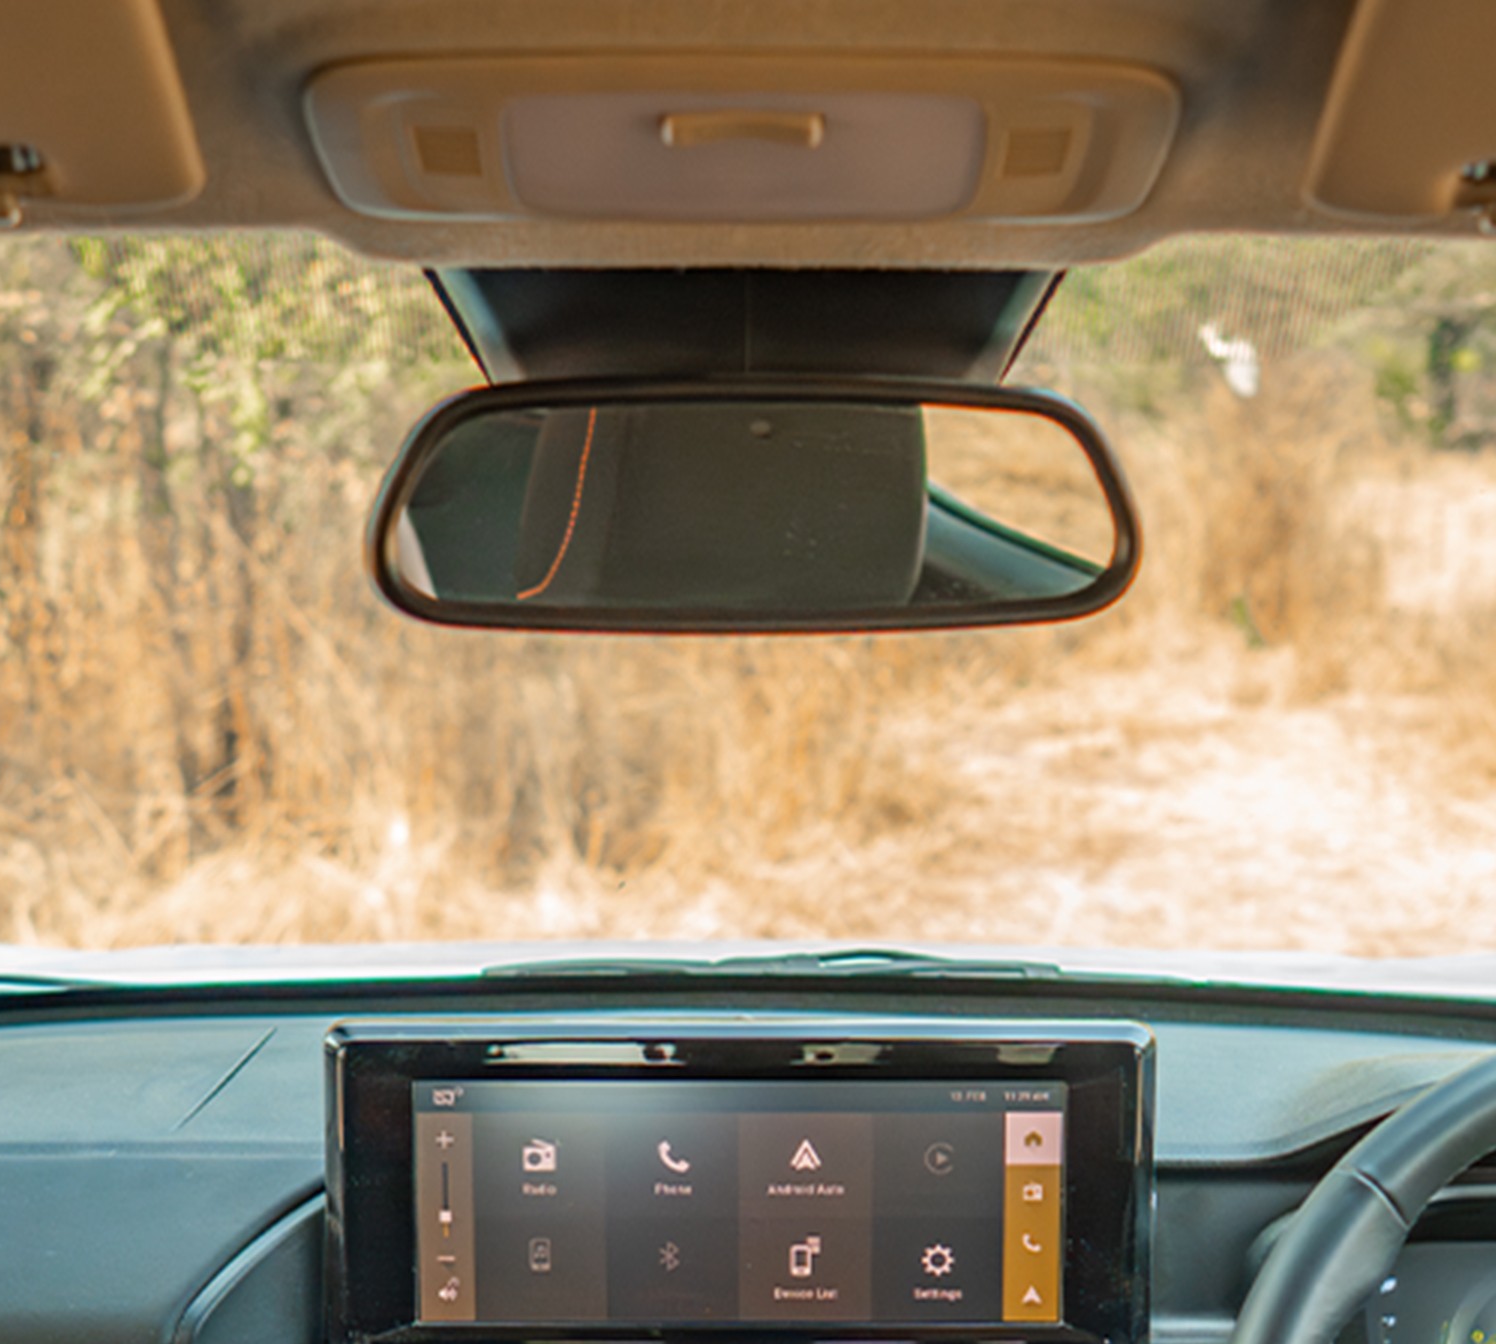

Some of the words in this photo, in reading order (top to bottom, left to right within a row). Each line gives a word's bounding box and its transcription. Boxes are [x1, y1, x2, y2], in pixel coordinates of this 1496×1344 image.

[522, 1183, 557, 1196] Radio
[654, 1183, 692, 1196] Phone
[767, 1183, 813, 1196] Android
[817, 1183, 845, 1196] Auto
[913, 1287, 963, 1303] Settings
